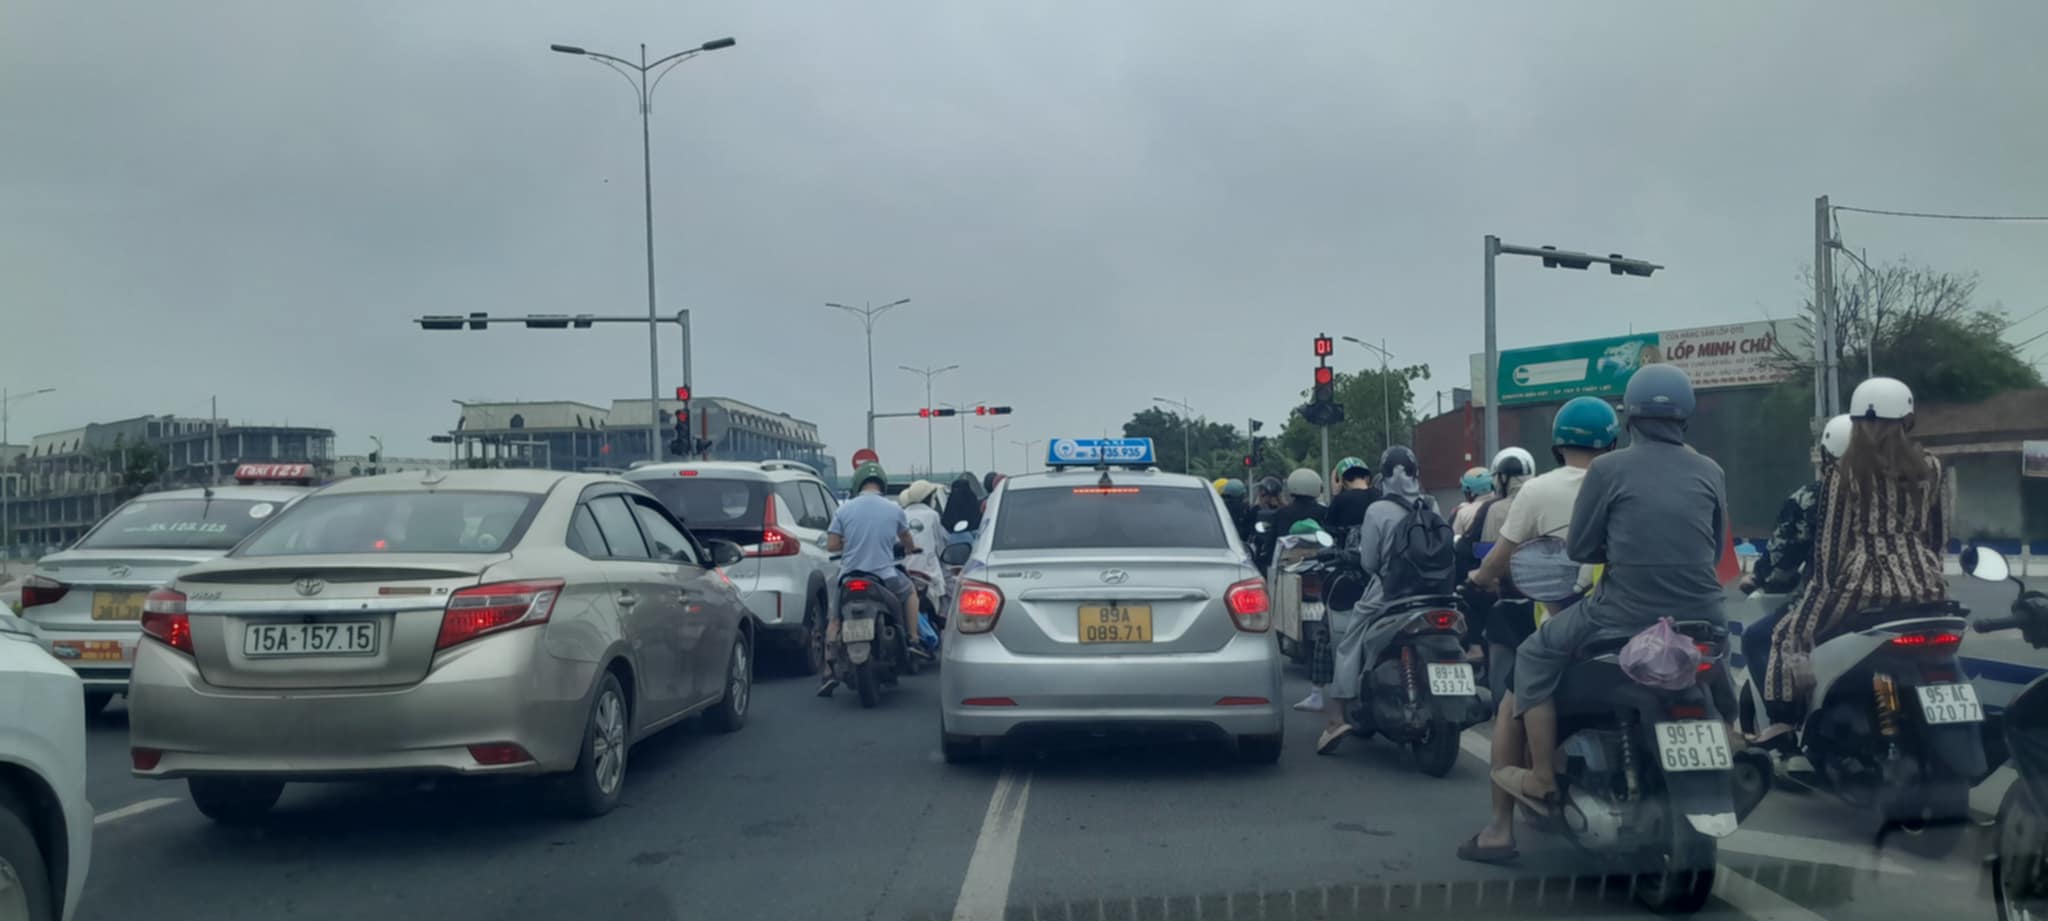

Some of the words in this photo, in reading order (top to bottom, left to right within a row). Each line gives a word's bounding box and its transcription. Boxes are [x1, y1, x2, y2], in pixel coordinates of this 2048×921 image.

[1317, 340, 1331, 354] 01
[1666, 340, 1695, 361] LỐP
[1697, 340, 1736, 358] MINH
[272, 464, 302, 476] 123
[1099, 607, 1131, 623] 89A
[253, 625, 370, 652] 15A-157.15
[1087, 625, 1143, 641] 089.71
[1666, 723, 1716, 745] 99-F1
[1665, 746, 1728, 768] 669.15
